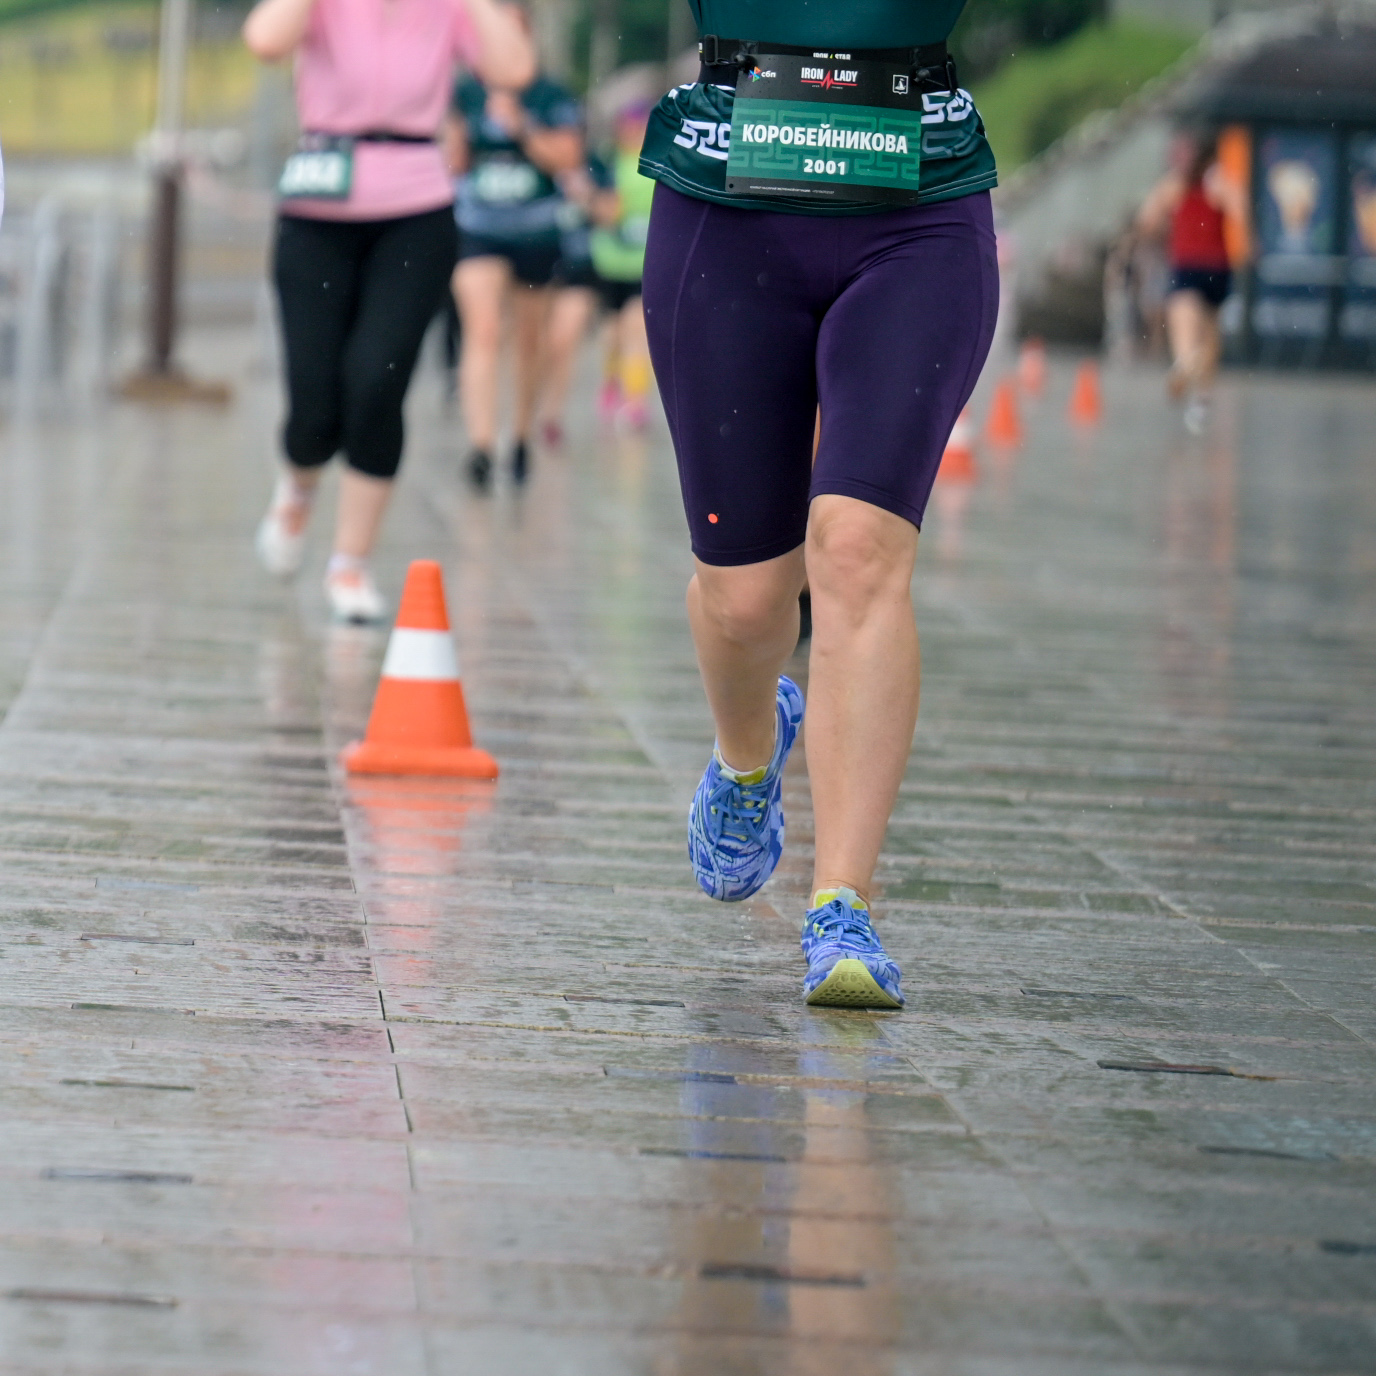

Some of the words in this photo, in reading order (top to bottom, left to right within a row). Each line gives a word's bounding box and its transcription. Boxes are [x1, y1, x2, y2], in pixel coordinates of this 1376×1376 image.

[801, 67, 824, 80] IRON
[834, 69, 858, 82] LADY
[742, 123, 908, 154] КОРОБЕЙНИКОВА
[803, 158, 846, 176] 2001
